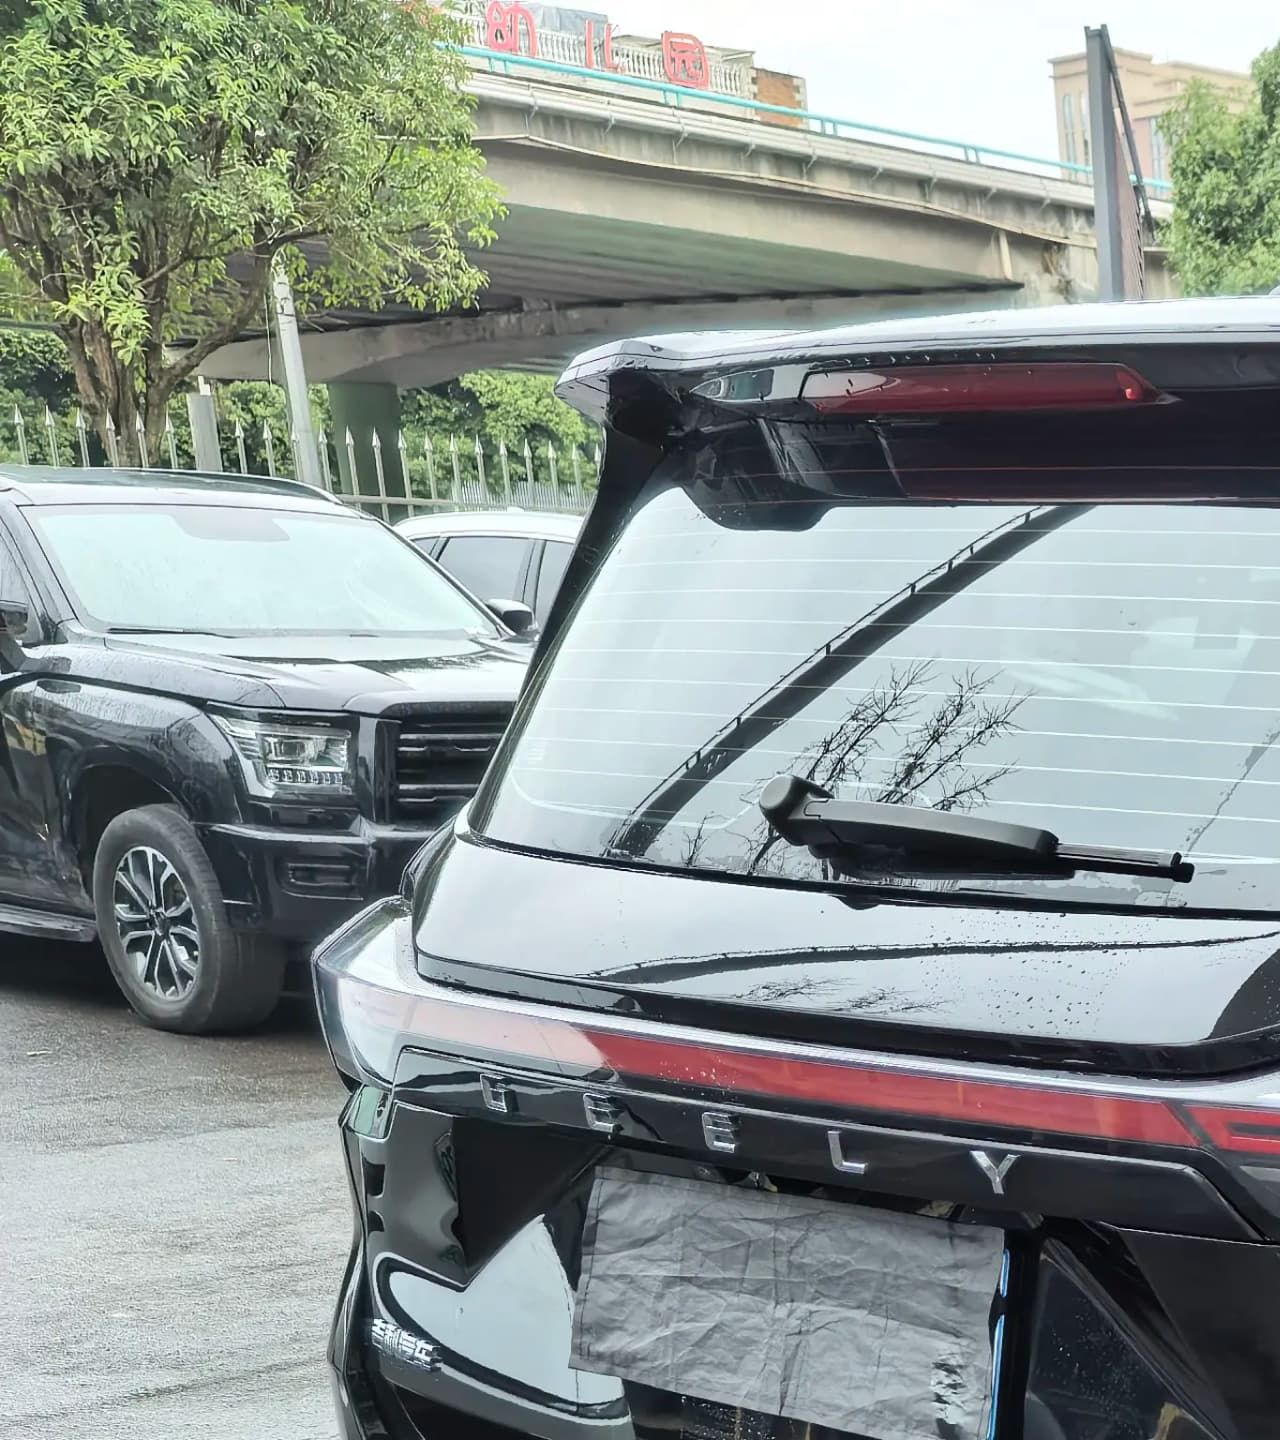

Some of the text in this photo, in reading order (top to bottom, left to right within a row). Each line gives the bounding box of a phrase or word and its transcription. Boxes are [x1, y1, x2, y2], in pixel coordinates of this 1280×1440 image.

[486, 0, 710, 88] 幼儿园
[479, 1072, 1019, 1195] GEELY
